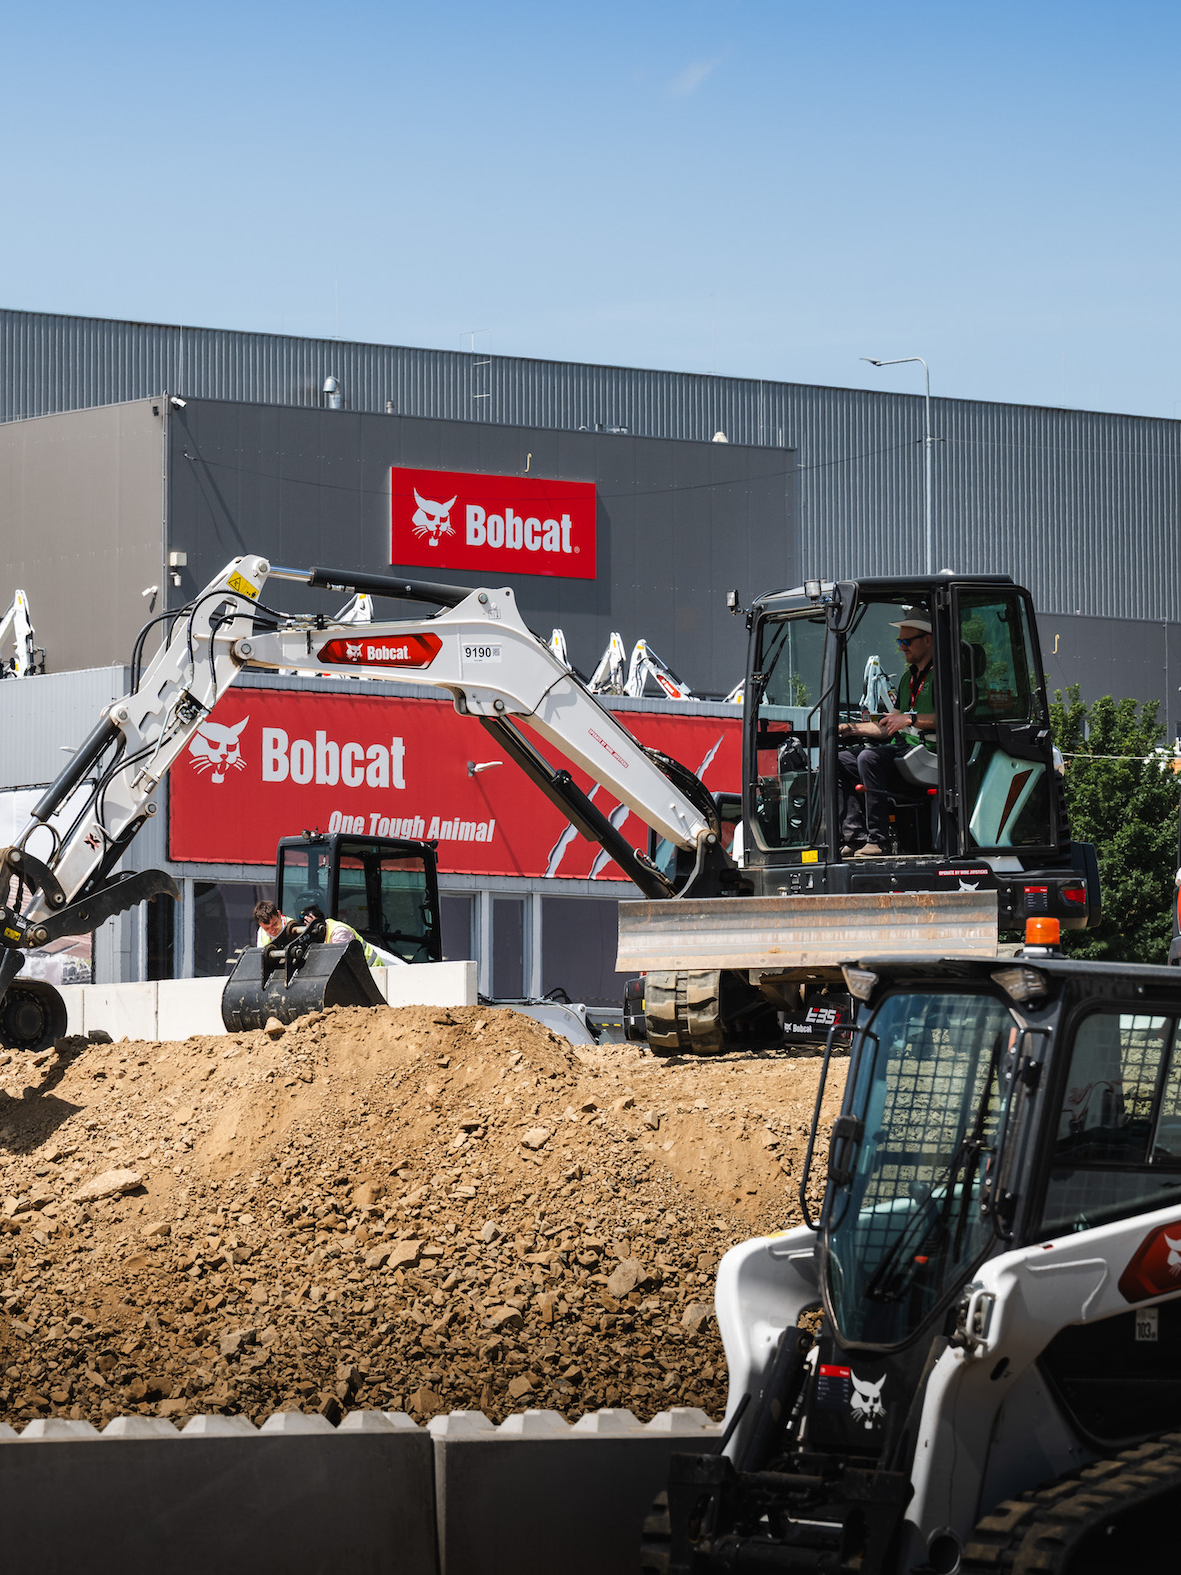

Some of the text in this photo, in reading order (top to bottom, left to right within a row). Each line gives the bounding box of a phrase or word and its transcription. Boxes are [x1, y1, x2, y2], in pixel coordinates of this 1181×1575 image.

[466, 504, 572, 553] Bobcat
[367, 645, 409, 660] Bobcat
[465, 647, 492, 658] 9190
[262, 727, 406, 789] Bobcat
[328, 810, 496, 843] One Tough Animal
[792, 1023, 813, 1034] Bobcat
